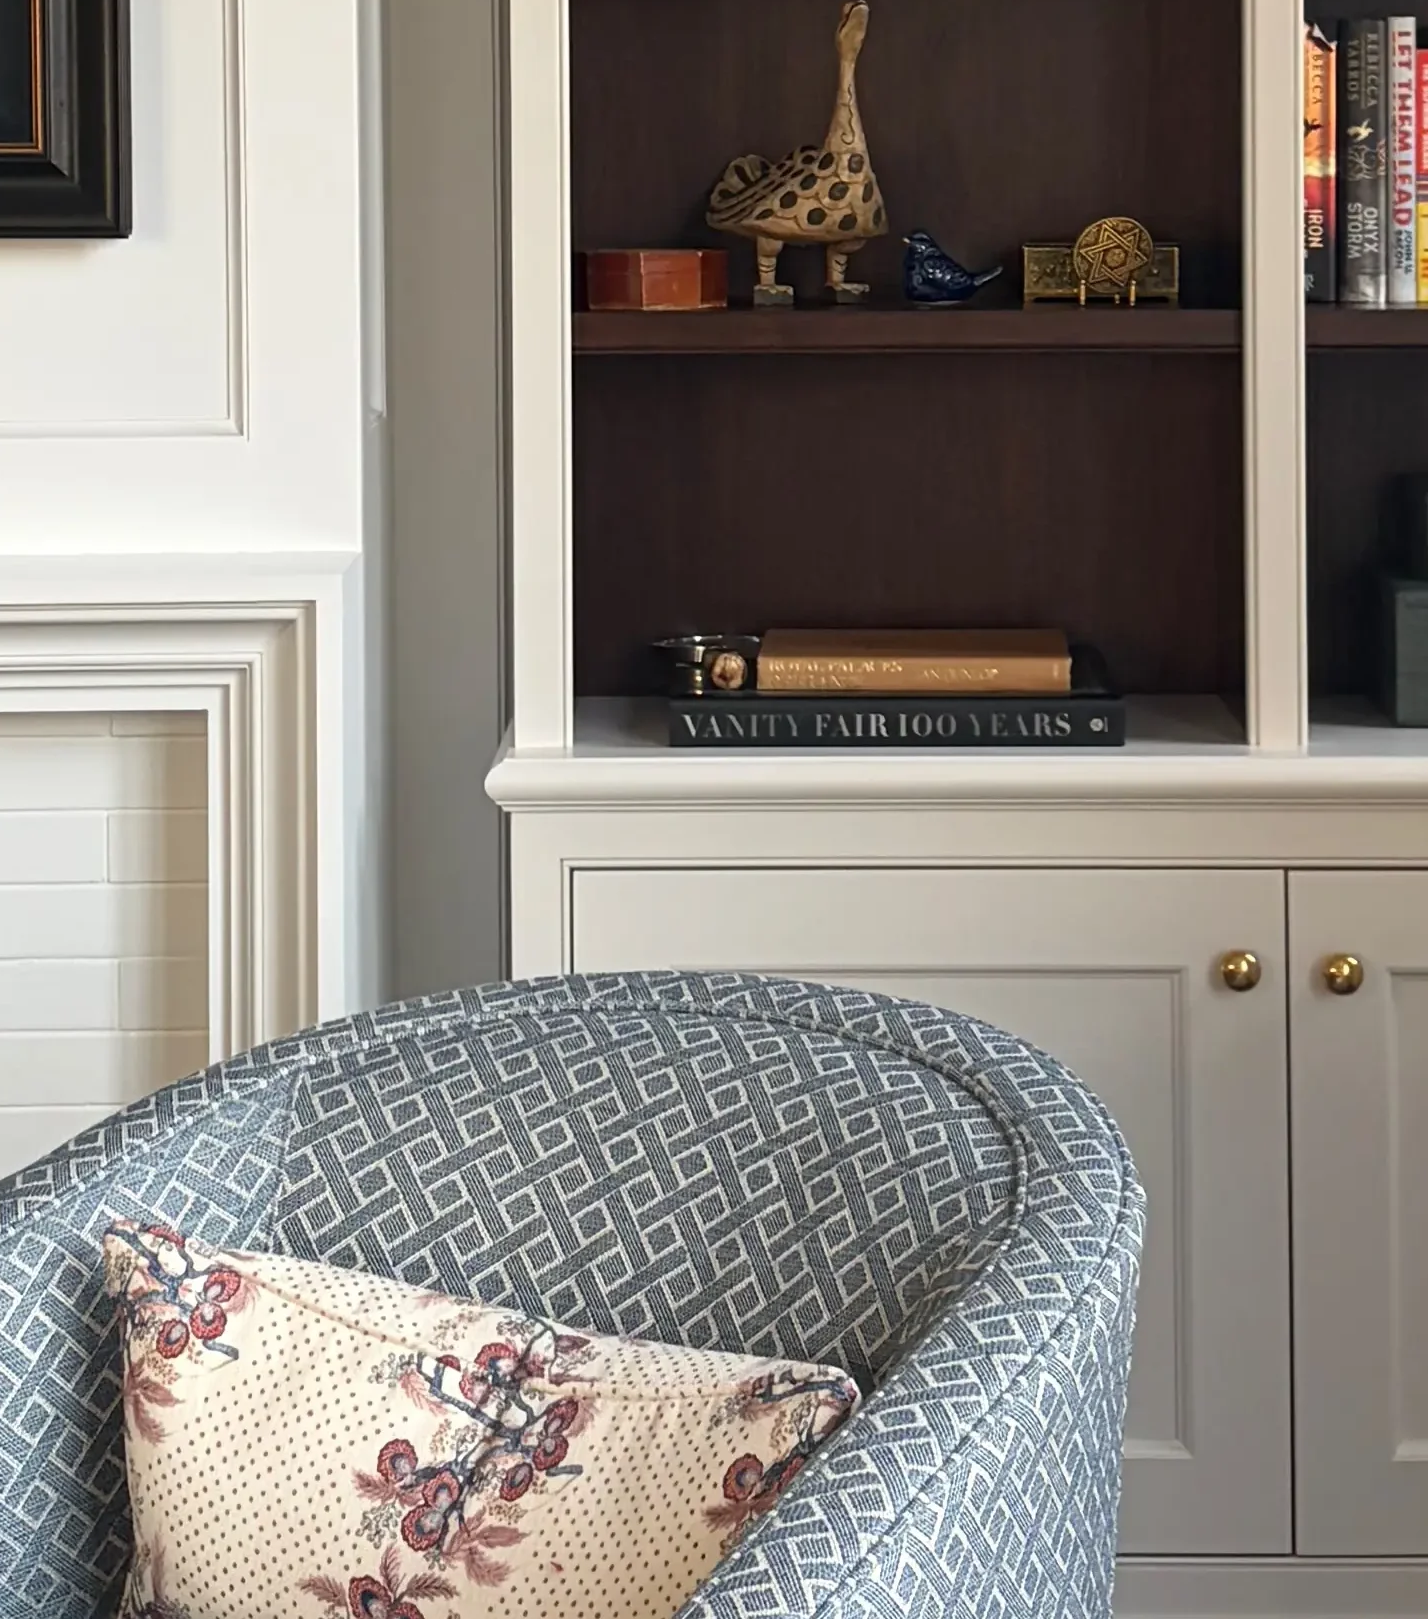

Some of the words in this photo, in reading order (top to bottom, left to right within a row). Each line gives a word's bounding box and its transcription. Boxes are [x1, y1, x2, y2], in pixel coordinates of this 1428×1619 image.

[1347, 40, 1360, 102] YARROS
[1366, 33, 1378, 107] REBECCA
[1392, 30, 1413, 70] LET
[1392, 78, 1413, 152] THEM
[1392, 160, 1413, 226] LEAD
[1308, 209, 1324, 248] IRON
[1347, 202, 1363, 258] STORM
[1363, 207, 1378, 253] ONYX
[1394, 229, 1404, 269] BACON
[1403, 229, 1413, 262] JOHN
[681, 714, 802, 739] VANITY
[815, 713, 889, 739] FAIR
[969, 712, 1072, 737] YEARS
